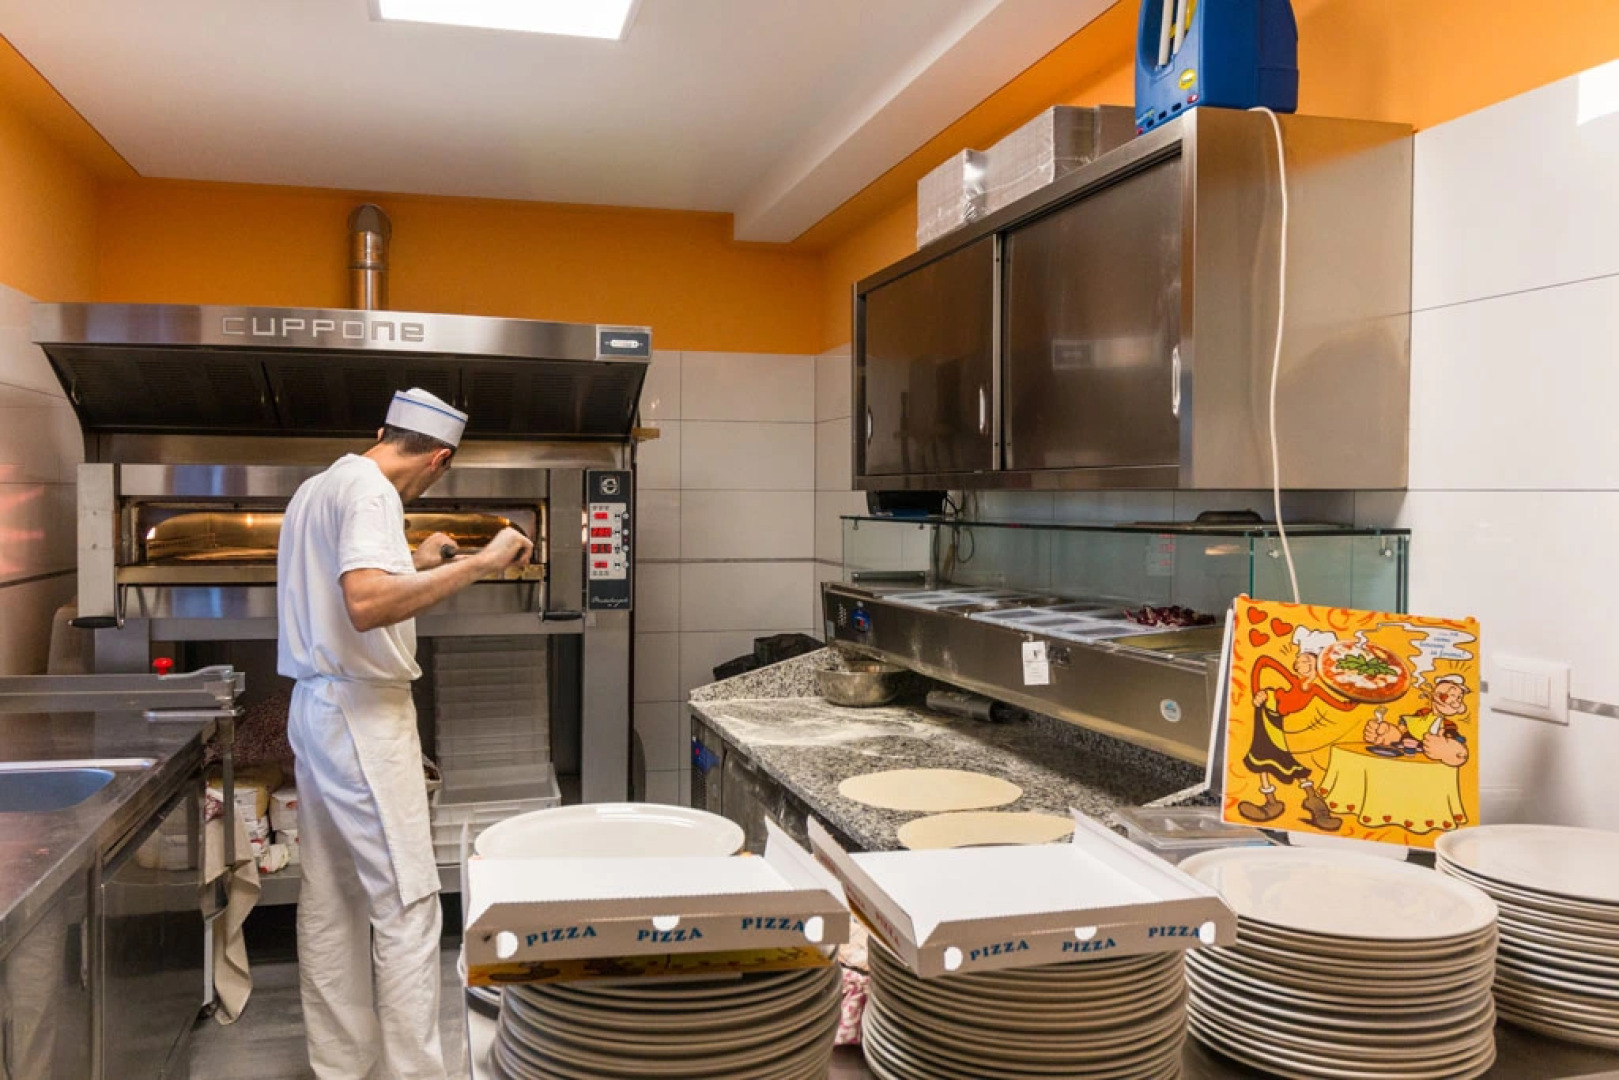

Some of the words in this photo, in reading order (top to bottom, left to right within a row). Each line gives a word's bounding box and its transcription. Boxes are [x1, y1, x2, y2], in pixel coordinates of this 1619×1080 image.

[741, 917, 804, 932] PIZZA
[1148, 926, 1200, 938] PIZZA
[525, 925, 597, 946] PIZZA
[637, 927, 703, 942] PIZZA
[970, 940, 1030, 960] PIZZA
[1062, 938, 1116, 952] PIZZA
